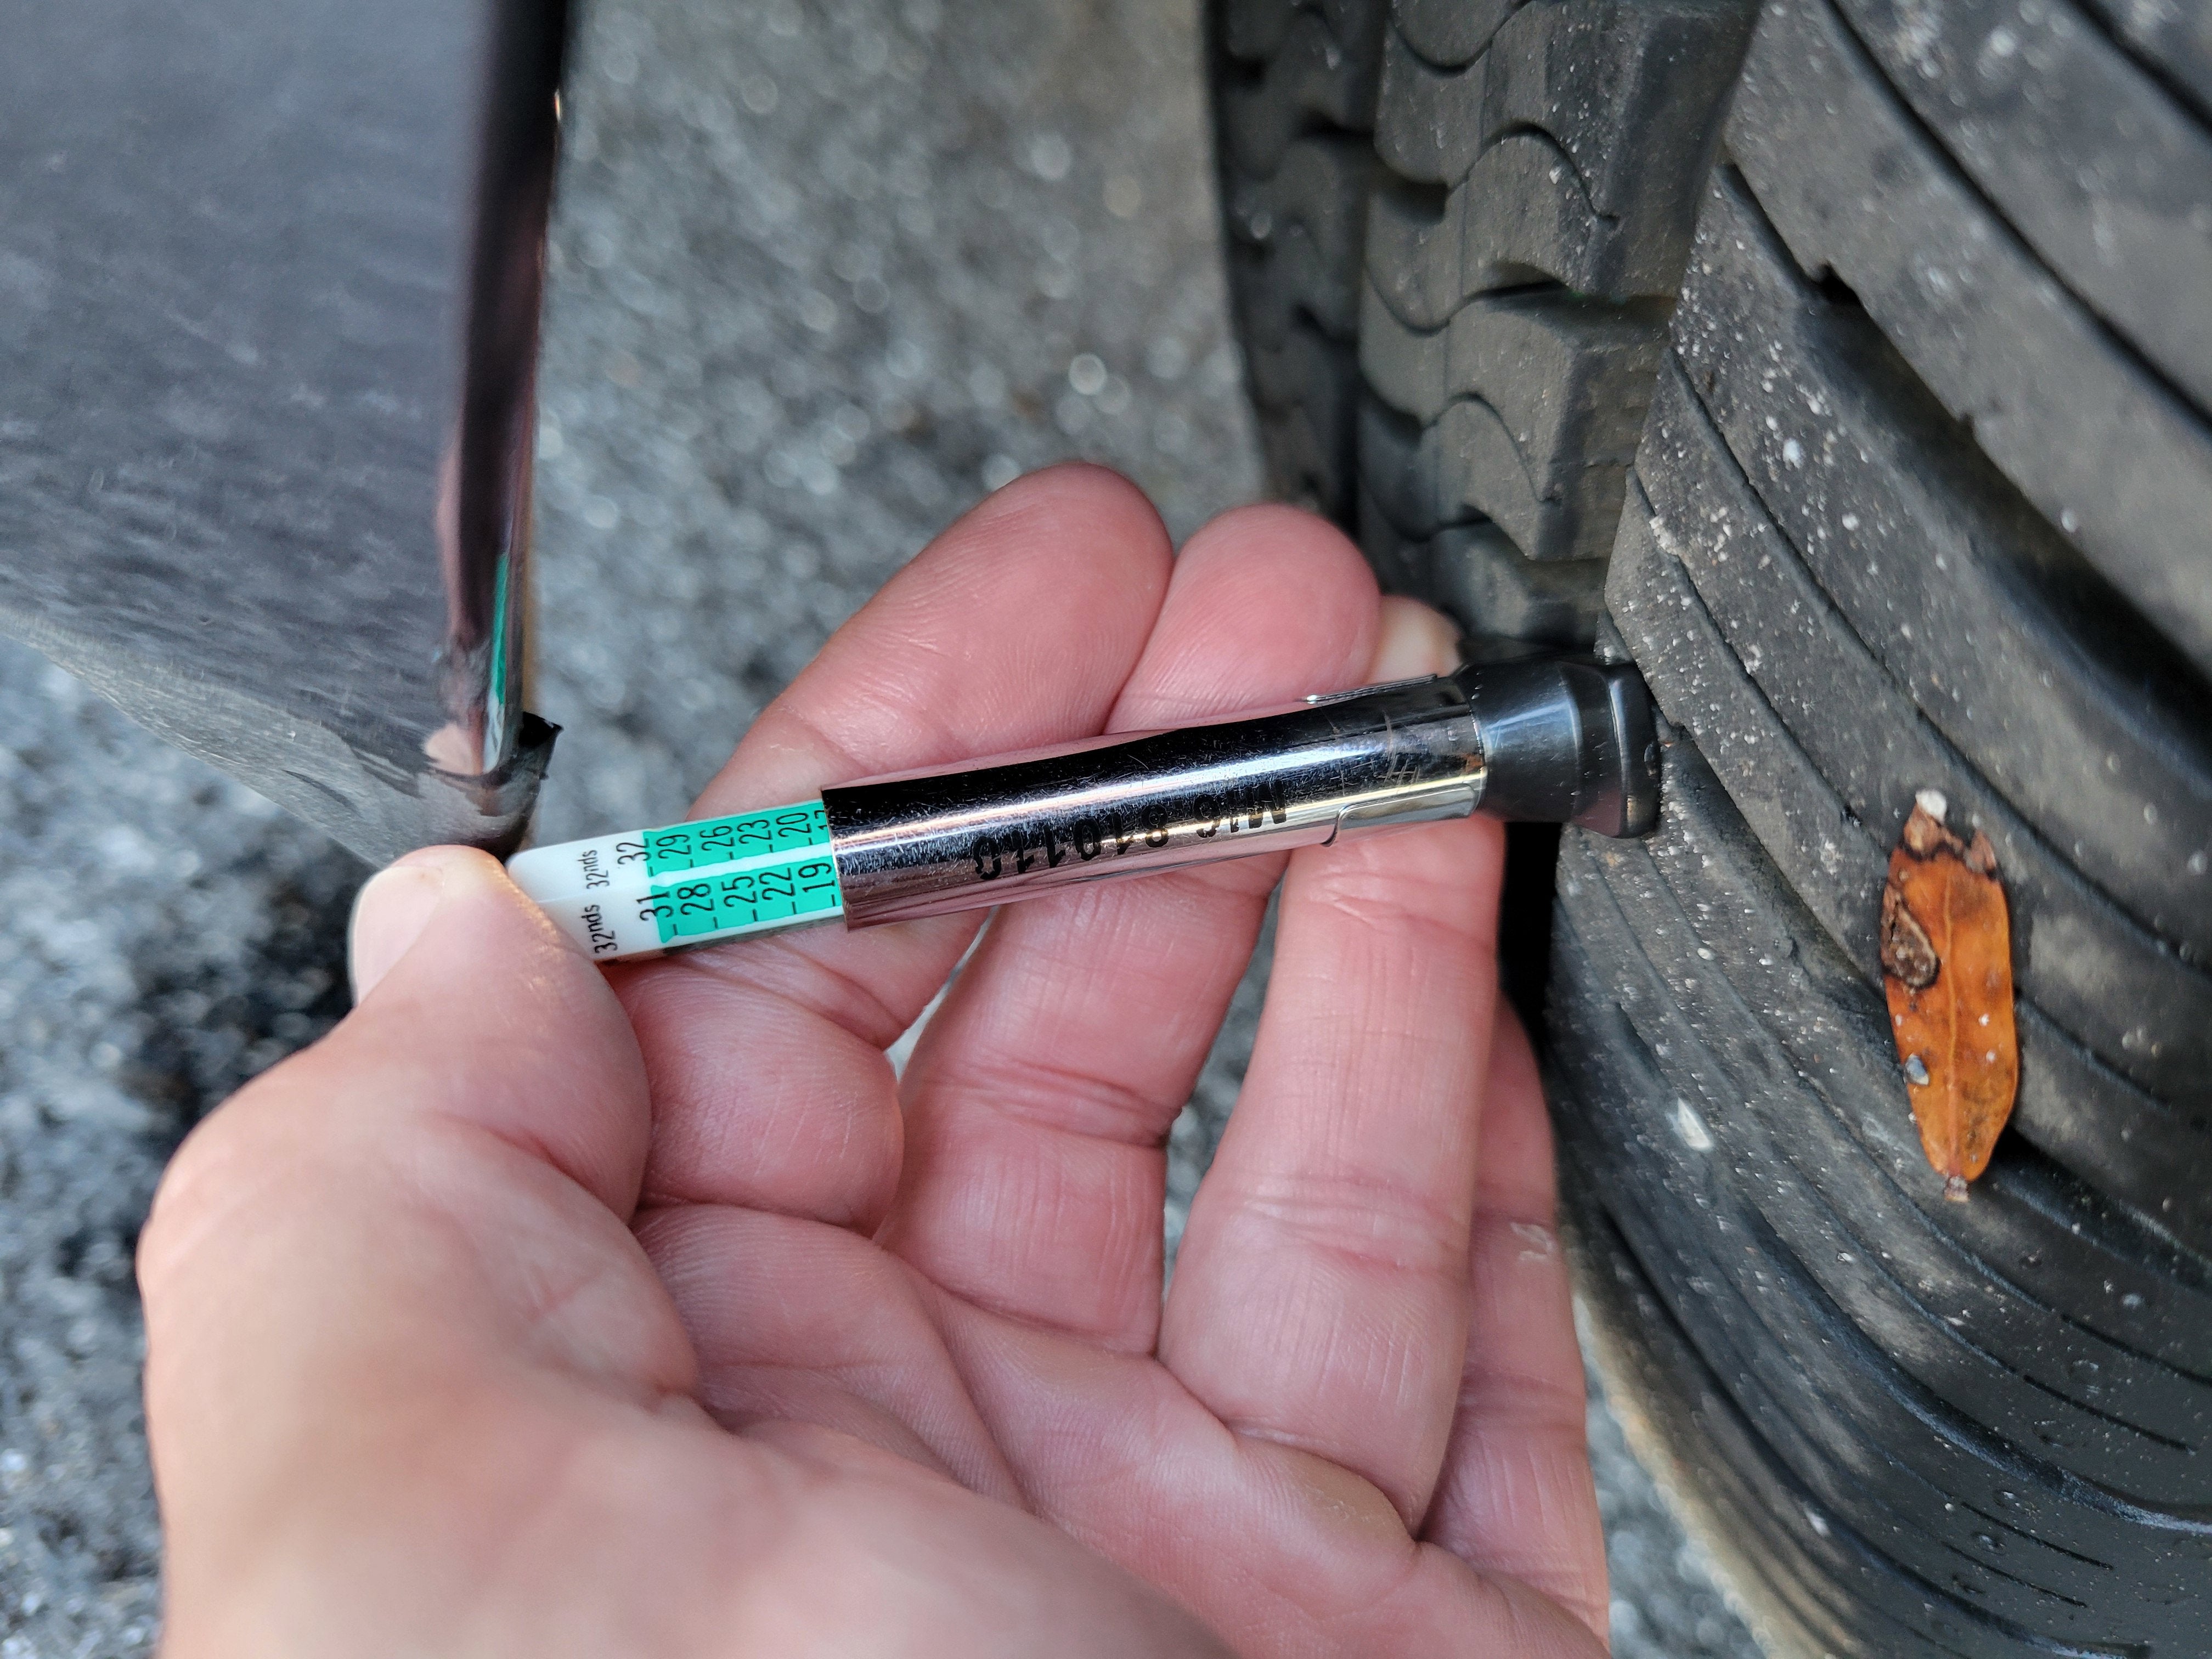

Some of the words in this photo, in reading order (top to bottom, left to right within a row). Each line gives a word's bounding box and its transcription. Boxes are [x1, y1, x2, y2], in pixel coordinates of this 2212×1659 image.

[699, 826, 735, 851] 26
[736, 820, 772, 844] 23
[776, 812, 811, 837] 20
[616, 838, 651, 865] 32
[656, 834, 692, 859] 29
[578, 850, 610, 889] 32nds
[759, 867, 795, 900] 22
[798, 863, 835, 893] 19
[636, 891, 674, 921] 31
[677, 883, 715, 915] 28
[721, 876, 758, 907] 25
[581, 905, 618, 953] 32nds
